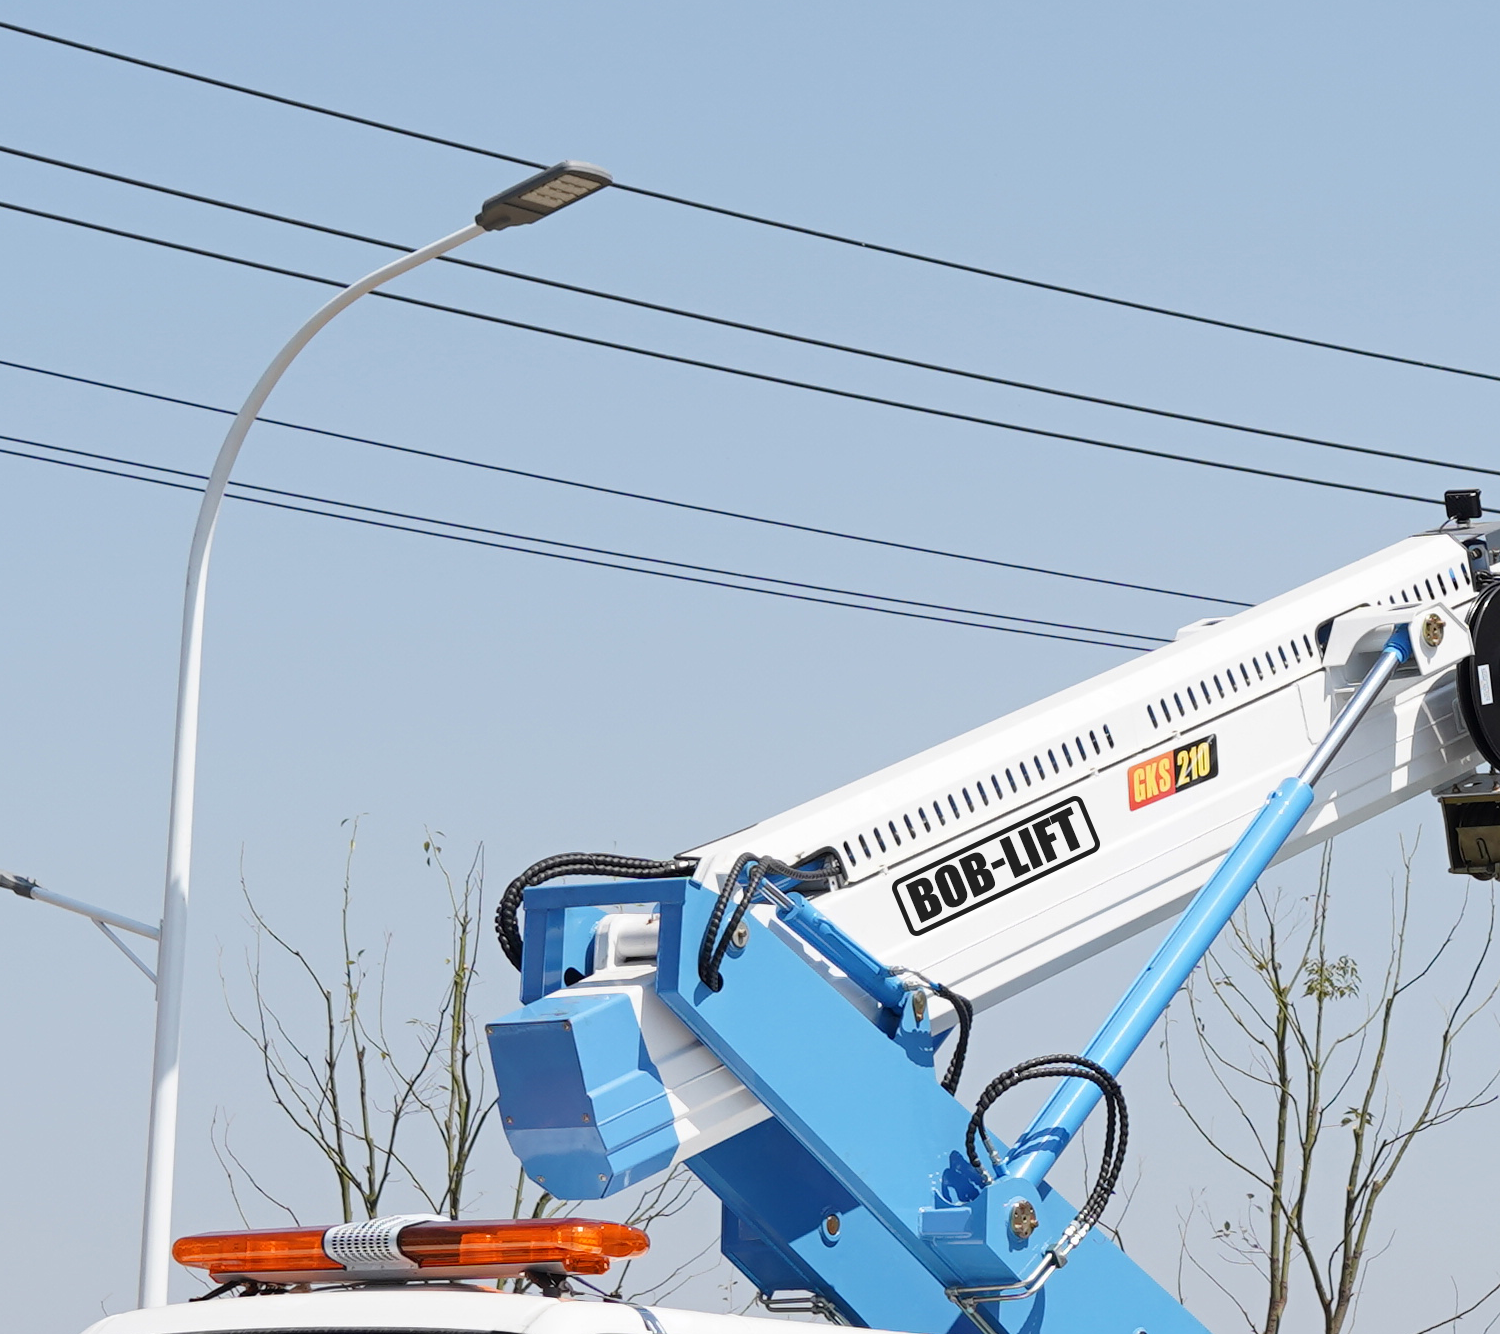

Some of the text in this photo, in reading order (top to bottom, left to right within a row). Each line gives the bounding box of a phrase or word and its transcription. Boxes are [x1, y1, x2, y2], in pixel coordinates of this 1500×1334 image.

[1133, 742, 1211, 803] GKS 210
[905, 806, 1081, 923] BOB-LIFT
